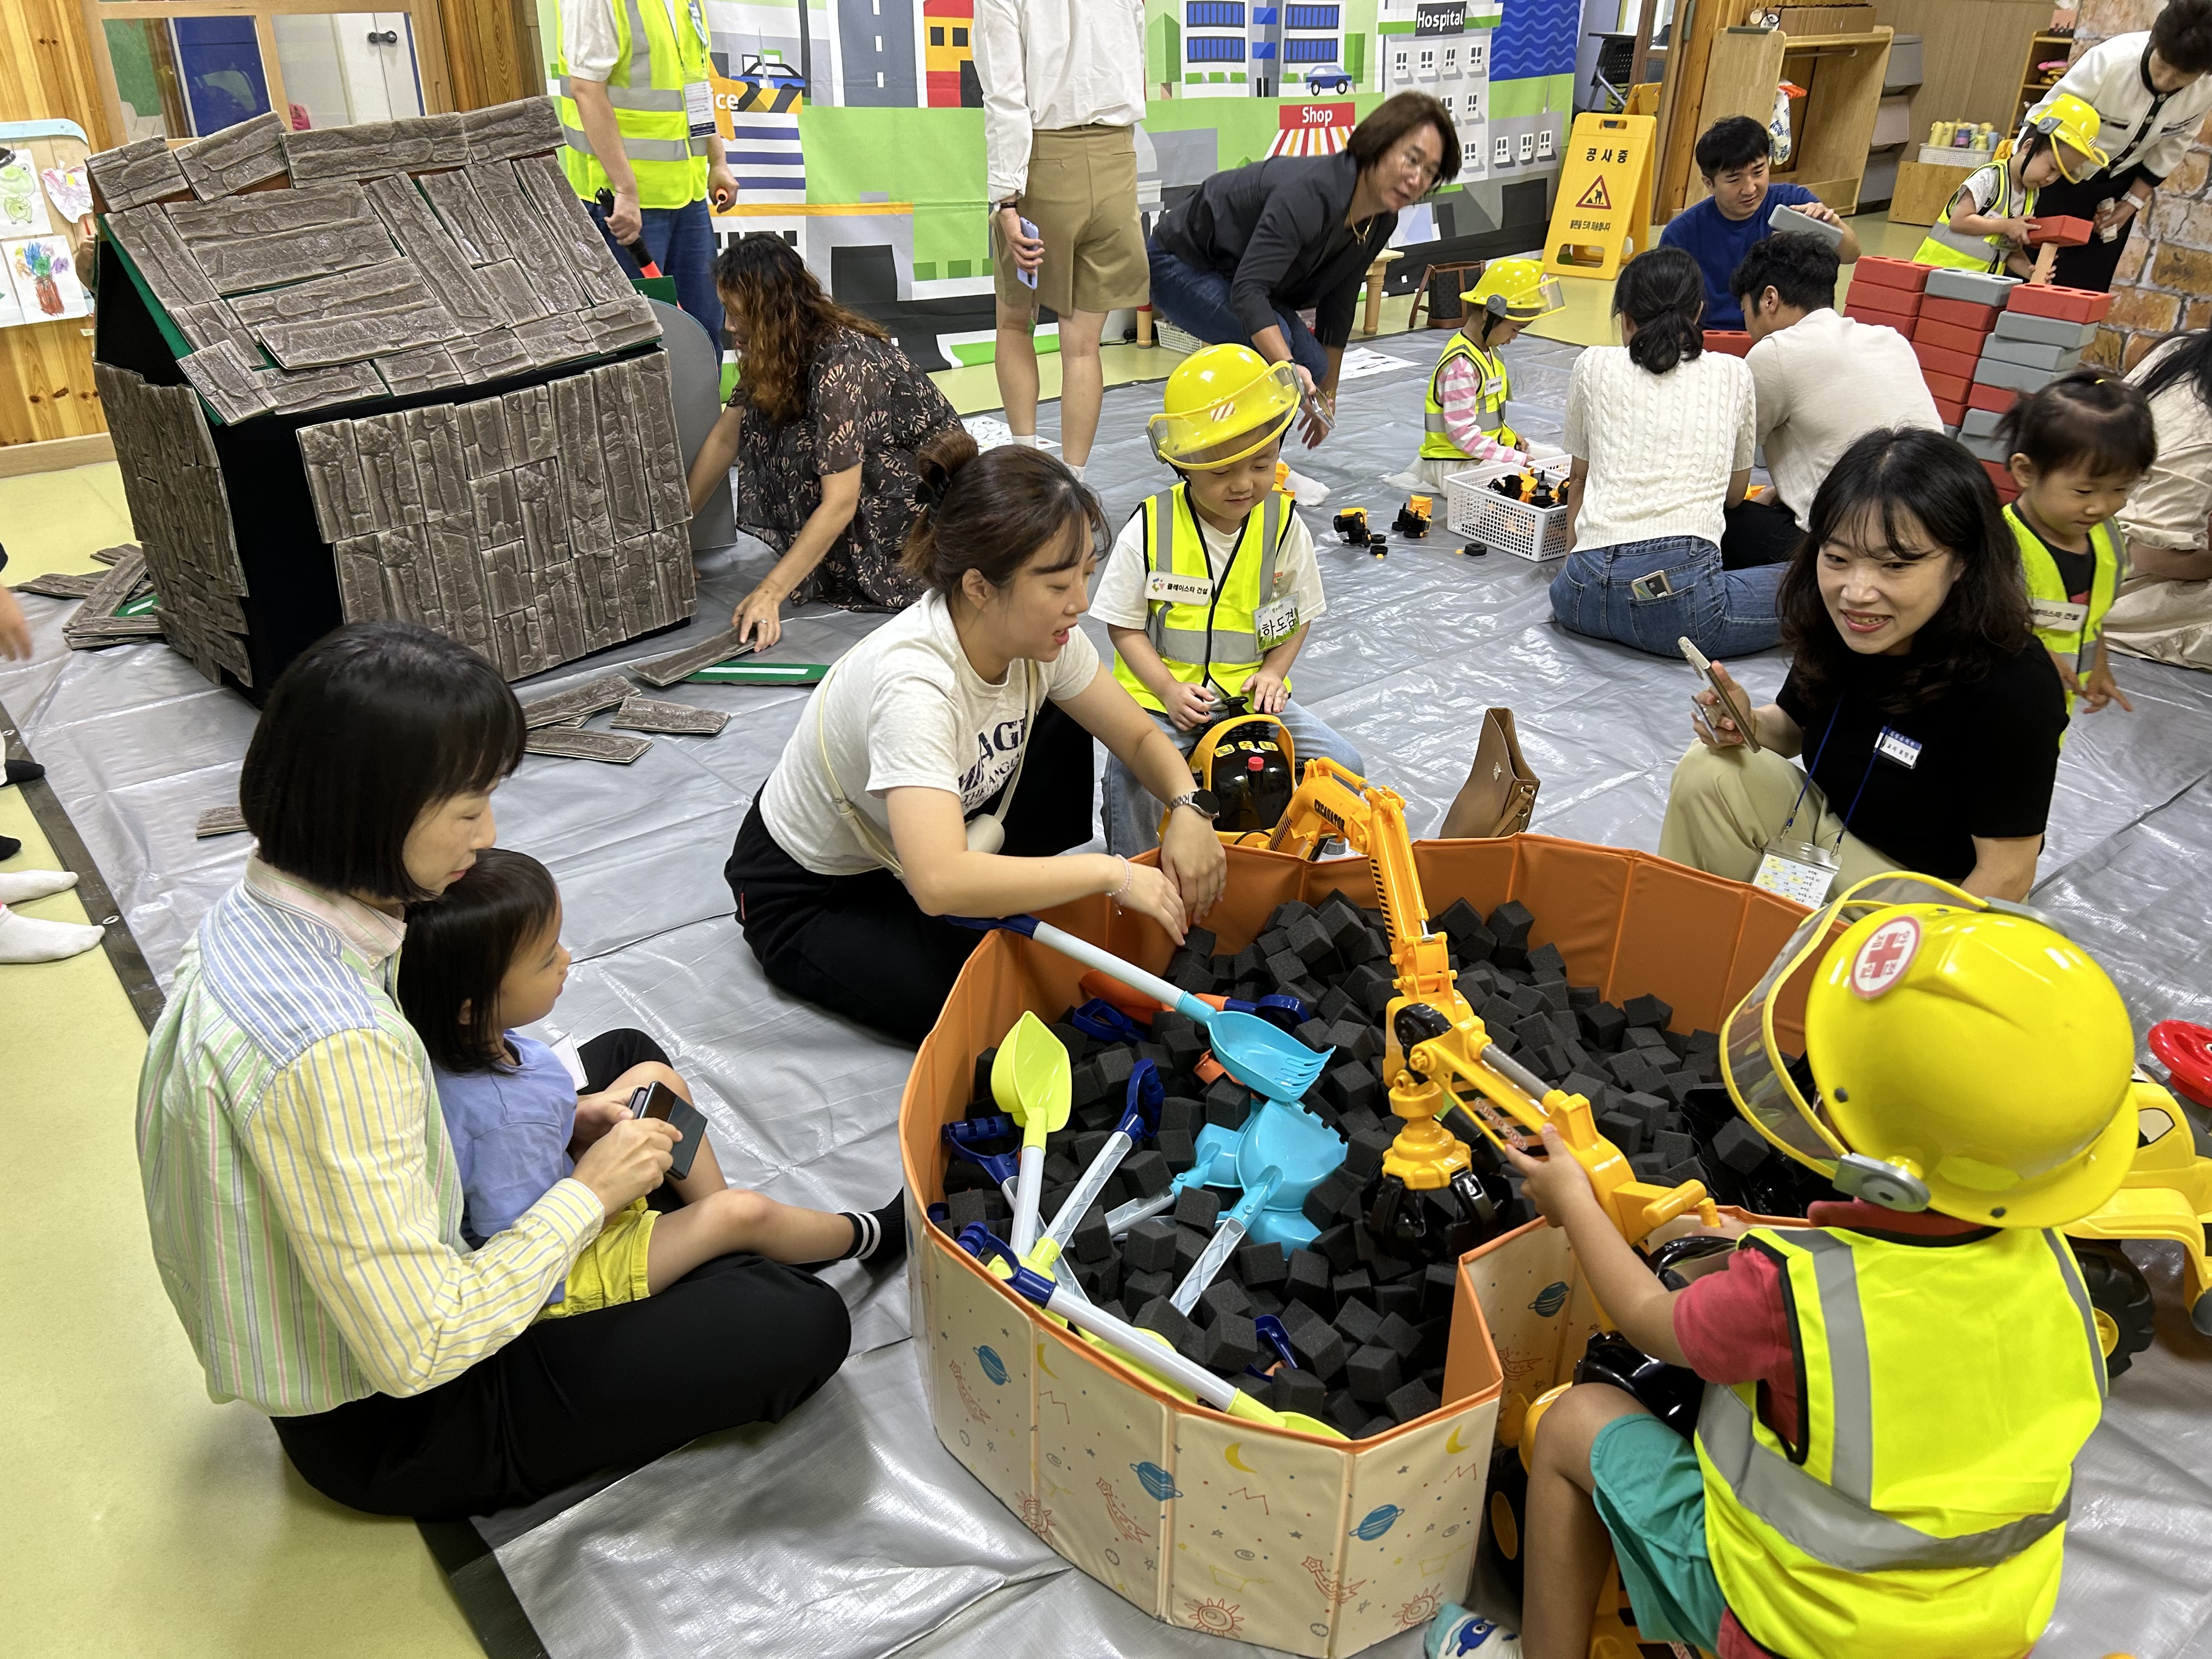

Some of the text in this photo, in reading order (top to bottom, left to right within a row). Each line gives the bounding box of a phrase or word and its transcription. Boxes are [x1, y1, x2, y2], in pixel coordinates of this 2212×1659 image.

[1417, 8, 1464, 32] Hospital
[1302, 106, 1333, 127] Shop
[1197, 586, 1208, 595] 건설
